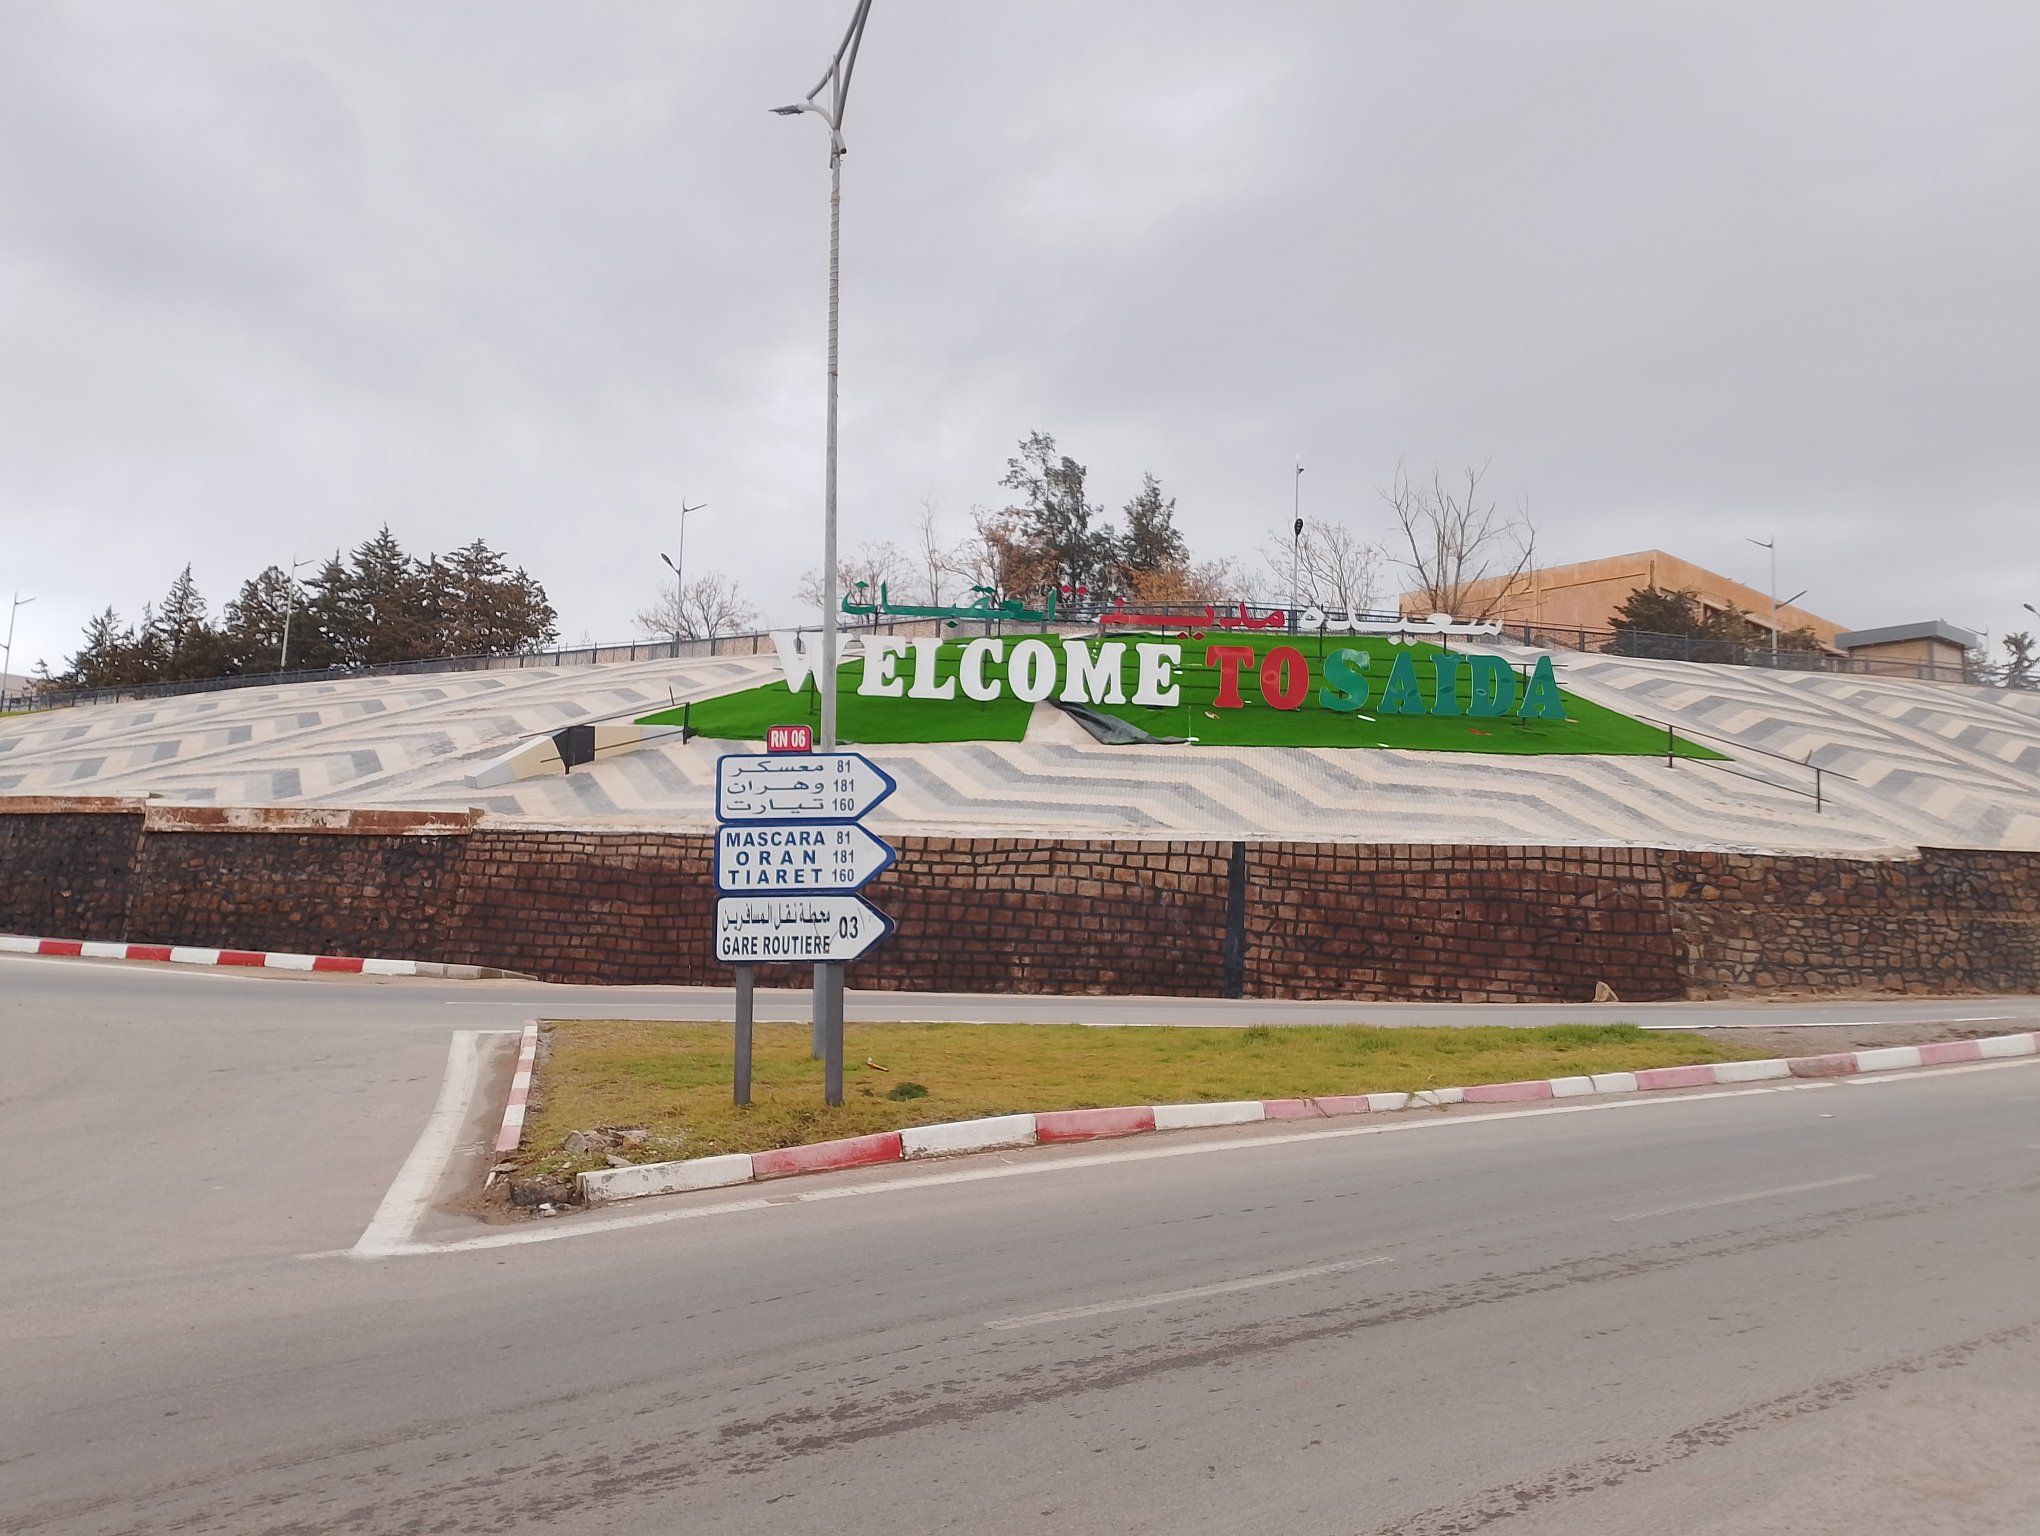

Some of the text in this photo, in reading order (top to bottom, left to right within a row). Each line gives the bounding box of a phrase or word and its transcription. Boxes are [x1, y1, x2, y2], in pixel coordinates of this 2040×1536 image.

[767, 631, 1182, 707] WELCOME
[1204, 645, 1310, 711] TO
[770, 730, 806, 748] RN 06
[728, 759, 851, 777] معسكر 81
[727, 778, 855, 794] وهران 181
[726, 798, 855, 815] تيارت 160
[726, 830, 851, 847] MASCARA 81
[735, 849, 855, 866] ORAN 181
[728, 868, 855, 885] TIARET 160
[722, 902, 831, 933] محطة نقل المسافرين
[838, 915, 859, 939] 03
[722, 935, 831, 955] GARE ROUTIERE
